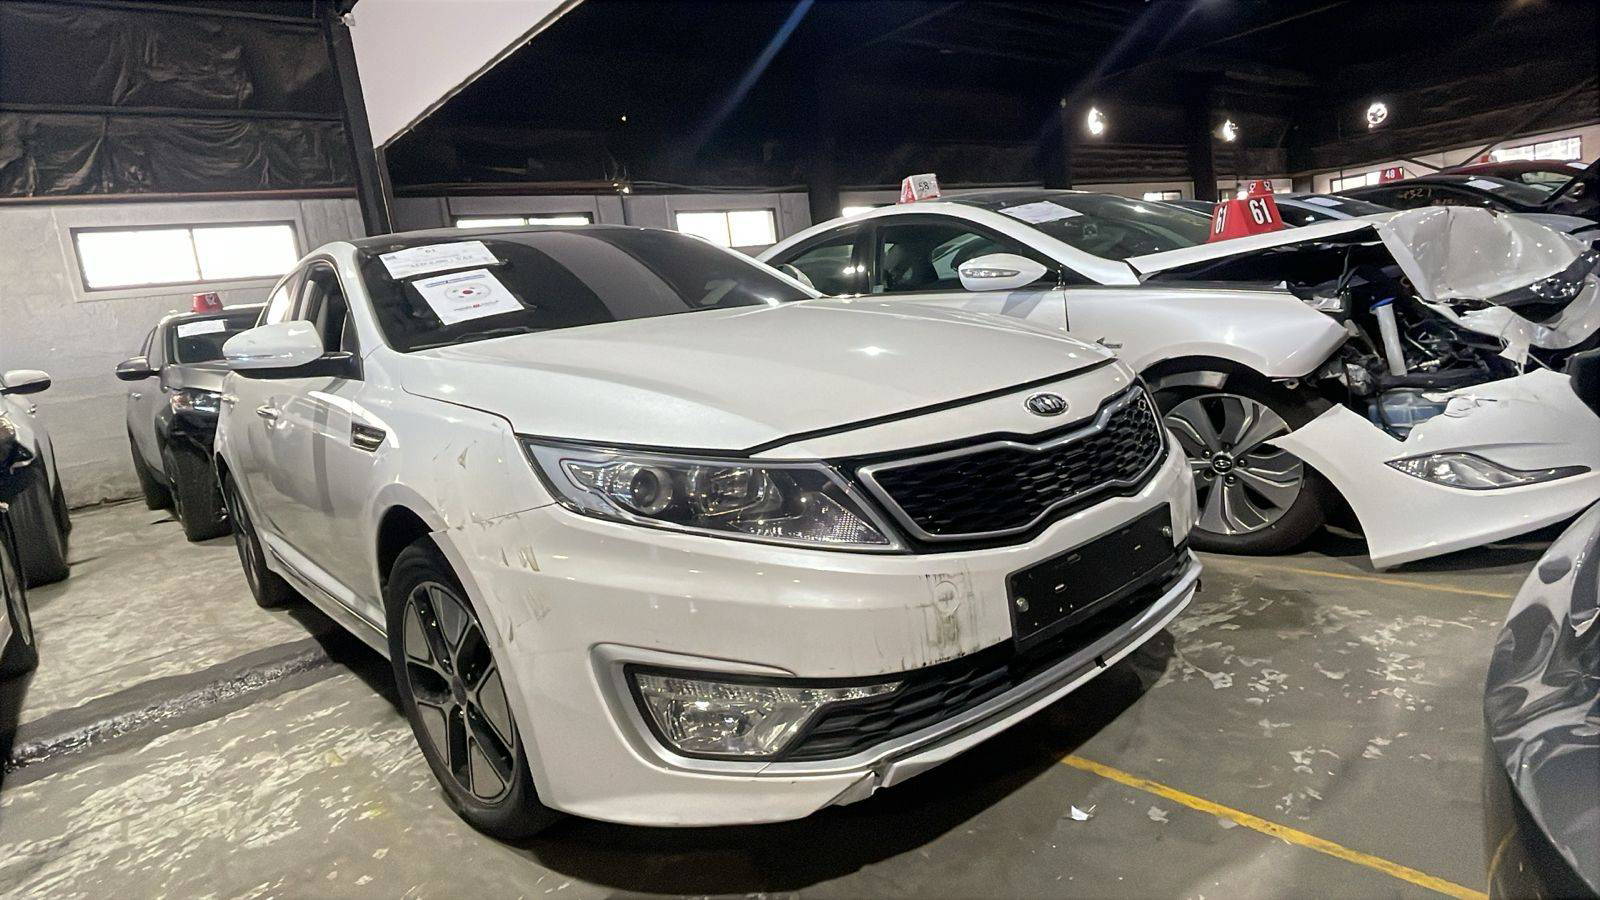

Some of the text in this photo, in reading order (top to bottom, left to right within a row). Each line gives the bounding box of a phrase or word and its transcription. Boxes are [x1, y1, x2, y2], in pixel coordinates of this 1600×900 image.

[1385, 169, 1396, 179] 48
[1215, 205, 1228, 234] 61
[1249, 198, 1272, 225] 61
